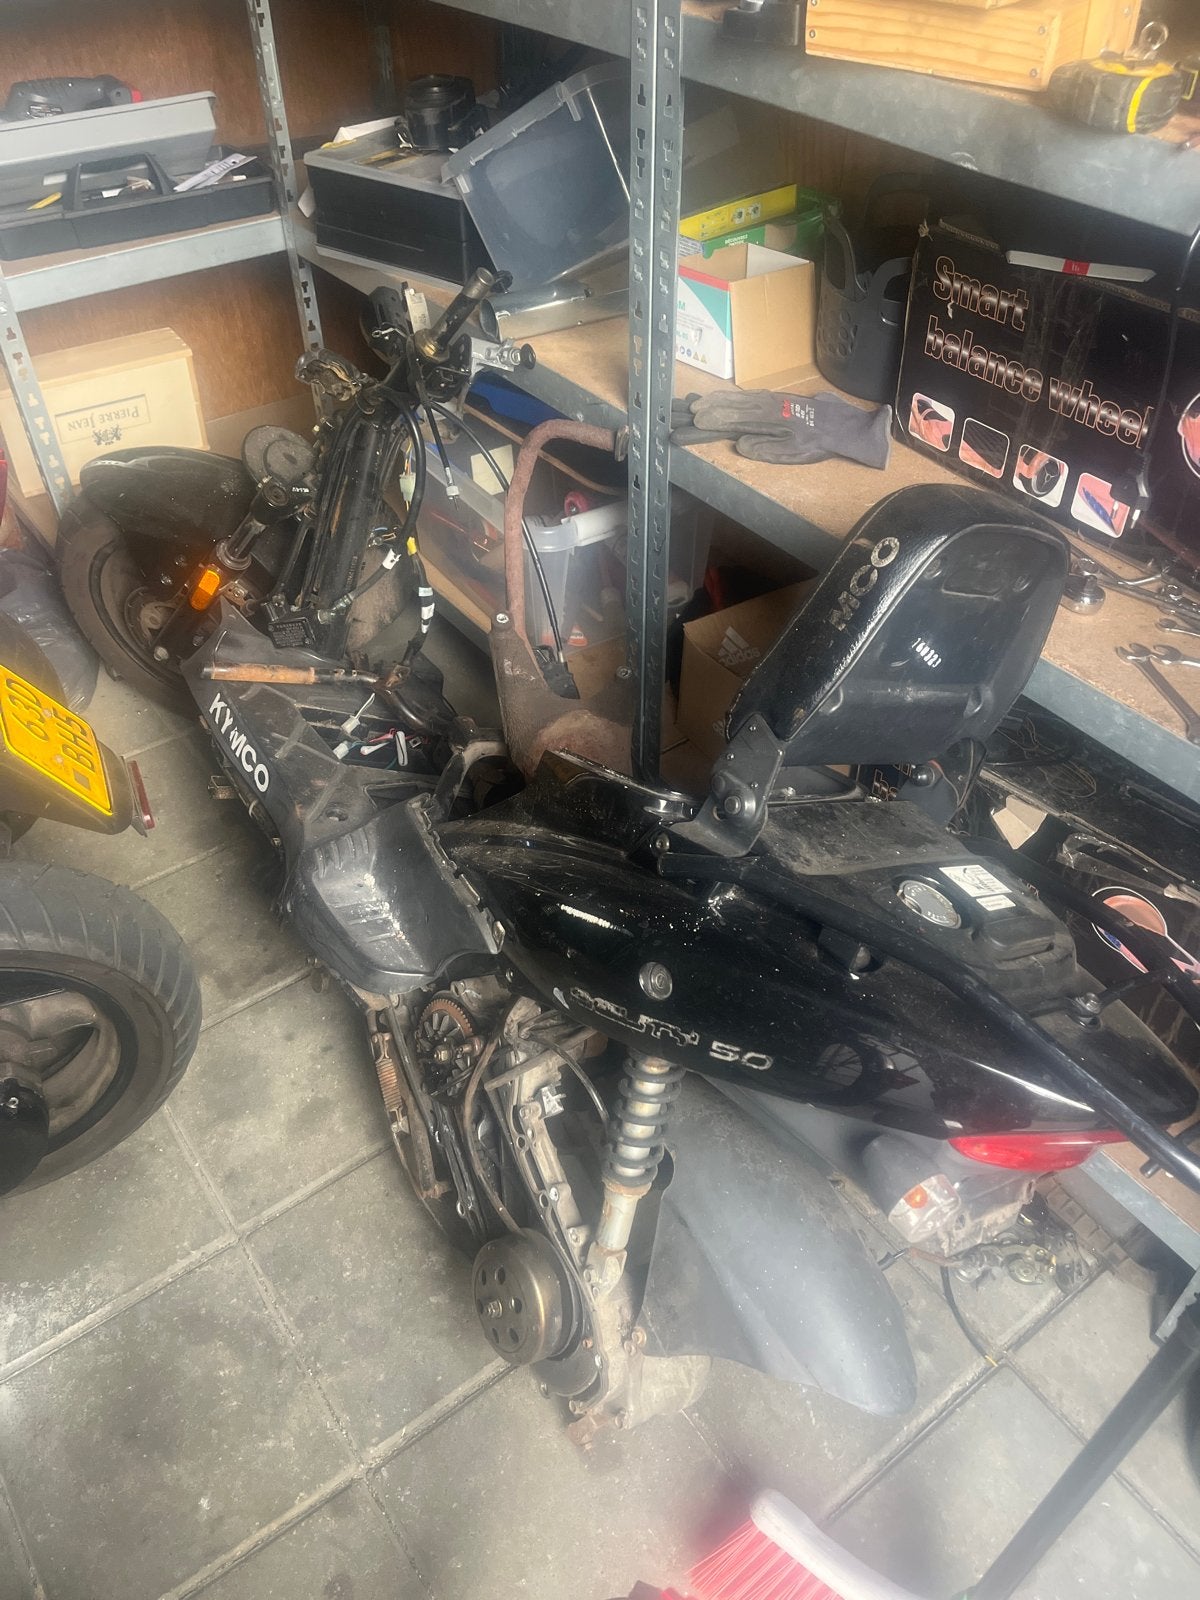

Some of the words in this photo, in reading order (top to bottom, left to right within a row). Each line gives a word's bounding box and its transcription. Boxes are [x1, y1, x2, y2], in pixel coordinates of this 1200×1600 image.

[933, 255, 1030, 332] Smart
[924, 314, 1044, 403] balance
[1048, 376, 1154, 449] wheel
[67, 412, 96, 432] JEAN
[98, 405, 140, 424] PIERRE
[718, 646, 761, 667] adidas
[5, 678, 50, 741] 63D
[208, 692, 270, 793] KYMCO
[708, 1039, 774, 1071] 50
